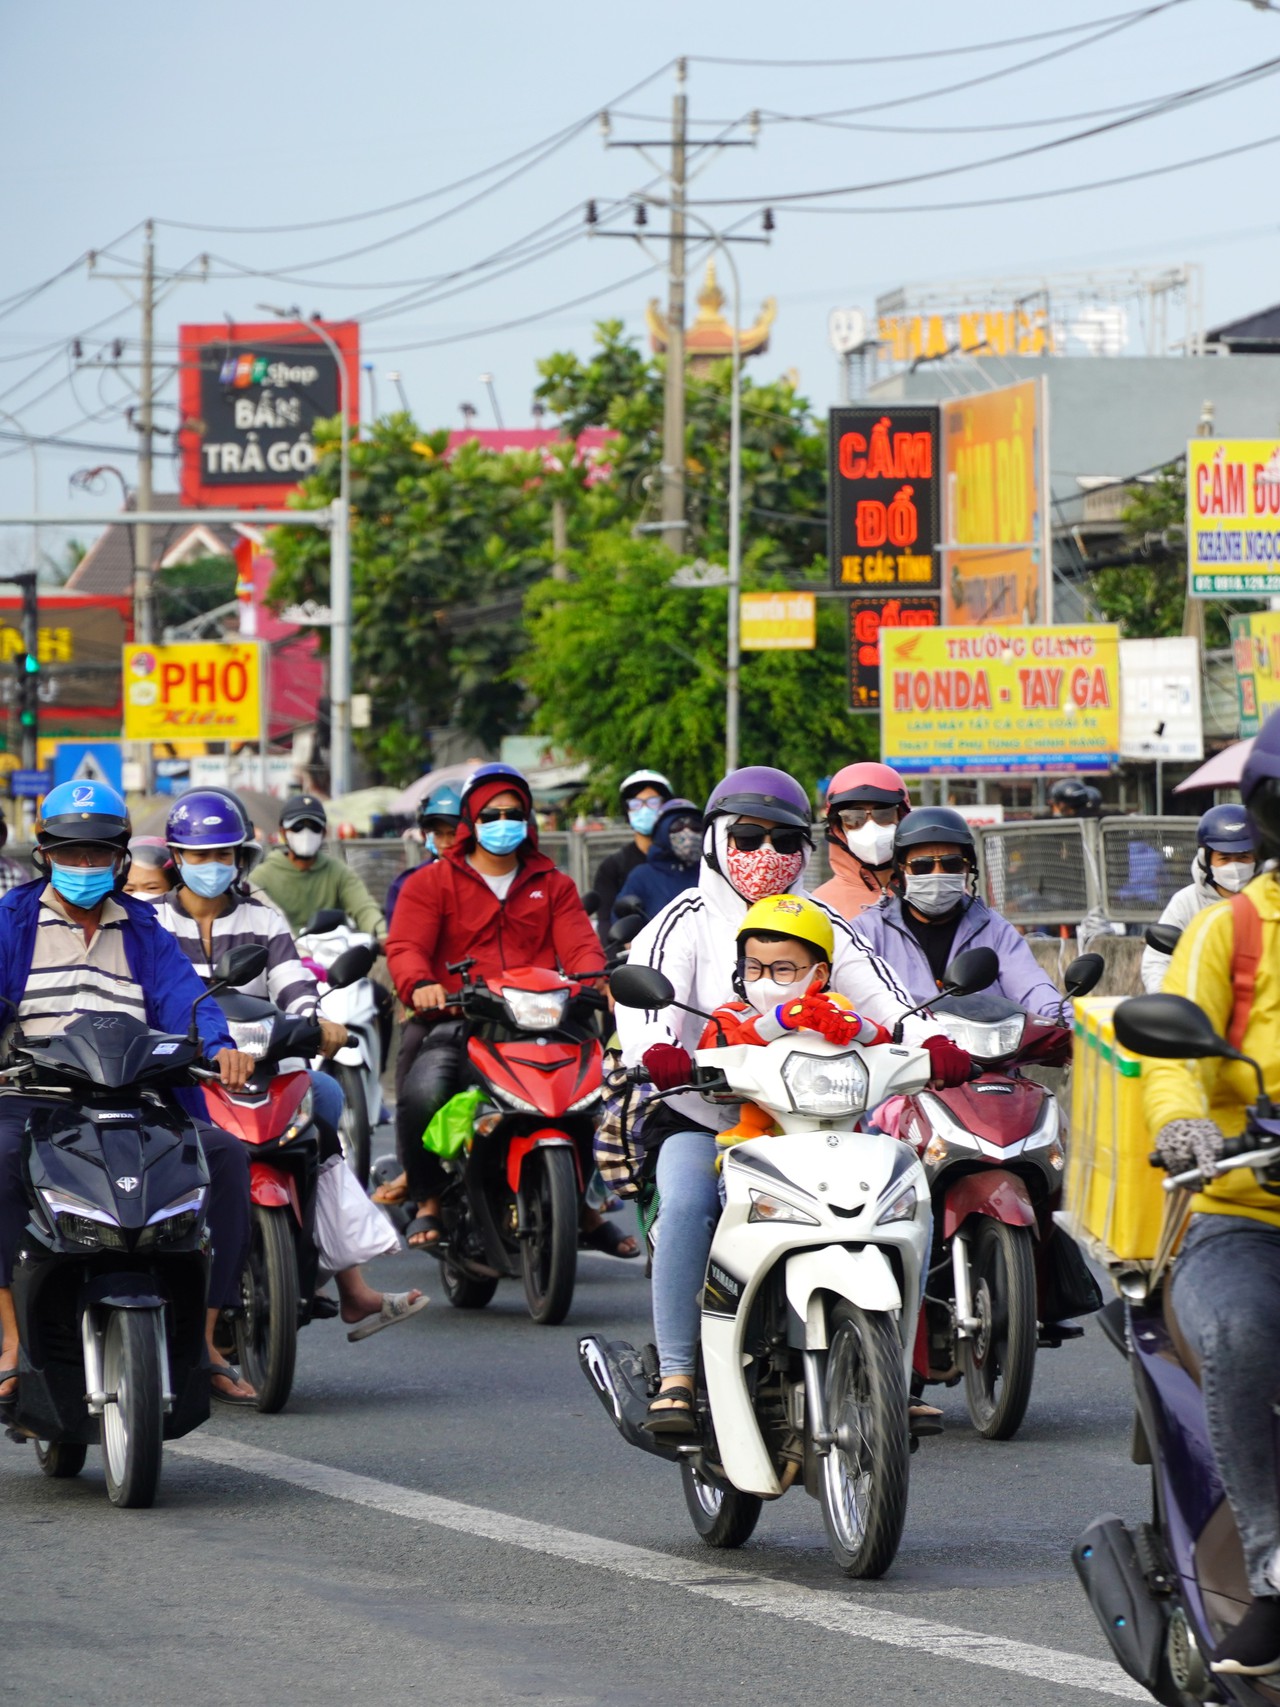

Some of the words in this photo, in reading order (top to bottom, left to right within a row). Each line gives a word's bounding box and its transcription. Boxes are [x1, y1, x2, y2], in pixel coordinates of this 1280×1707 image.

[202, 431, 266, 474] TRẢ
[1196, 522, 1243, 562] KHÁNH
[841, 555, 862, 584] XE
[864, 550, 895, 583] CÁC
[1031, 636, 1096, 658] GIANG
[160, 645, 252, 703] PHỞ
[892, 668, 992, 712] HONDA
[1018, 666, 1064, 709] TAY
[1071, 664, 1111, 708] GA
[977, 1085, 1012, 1093] HONDA
[711, 1263, 739, 1297] YAMAHA
